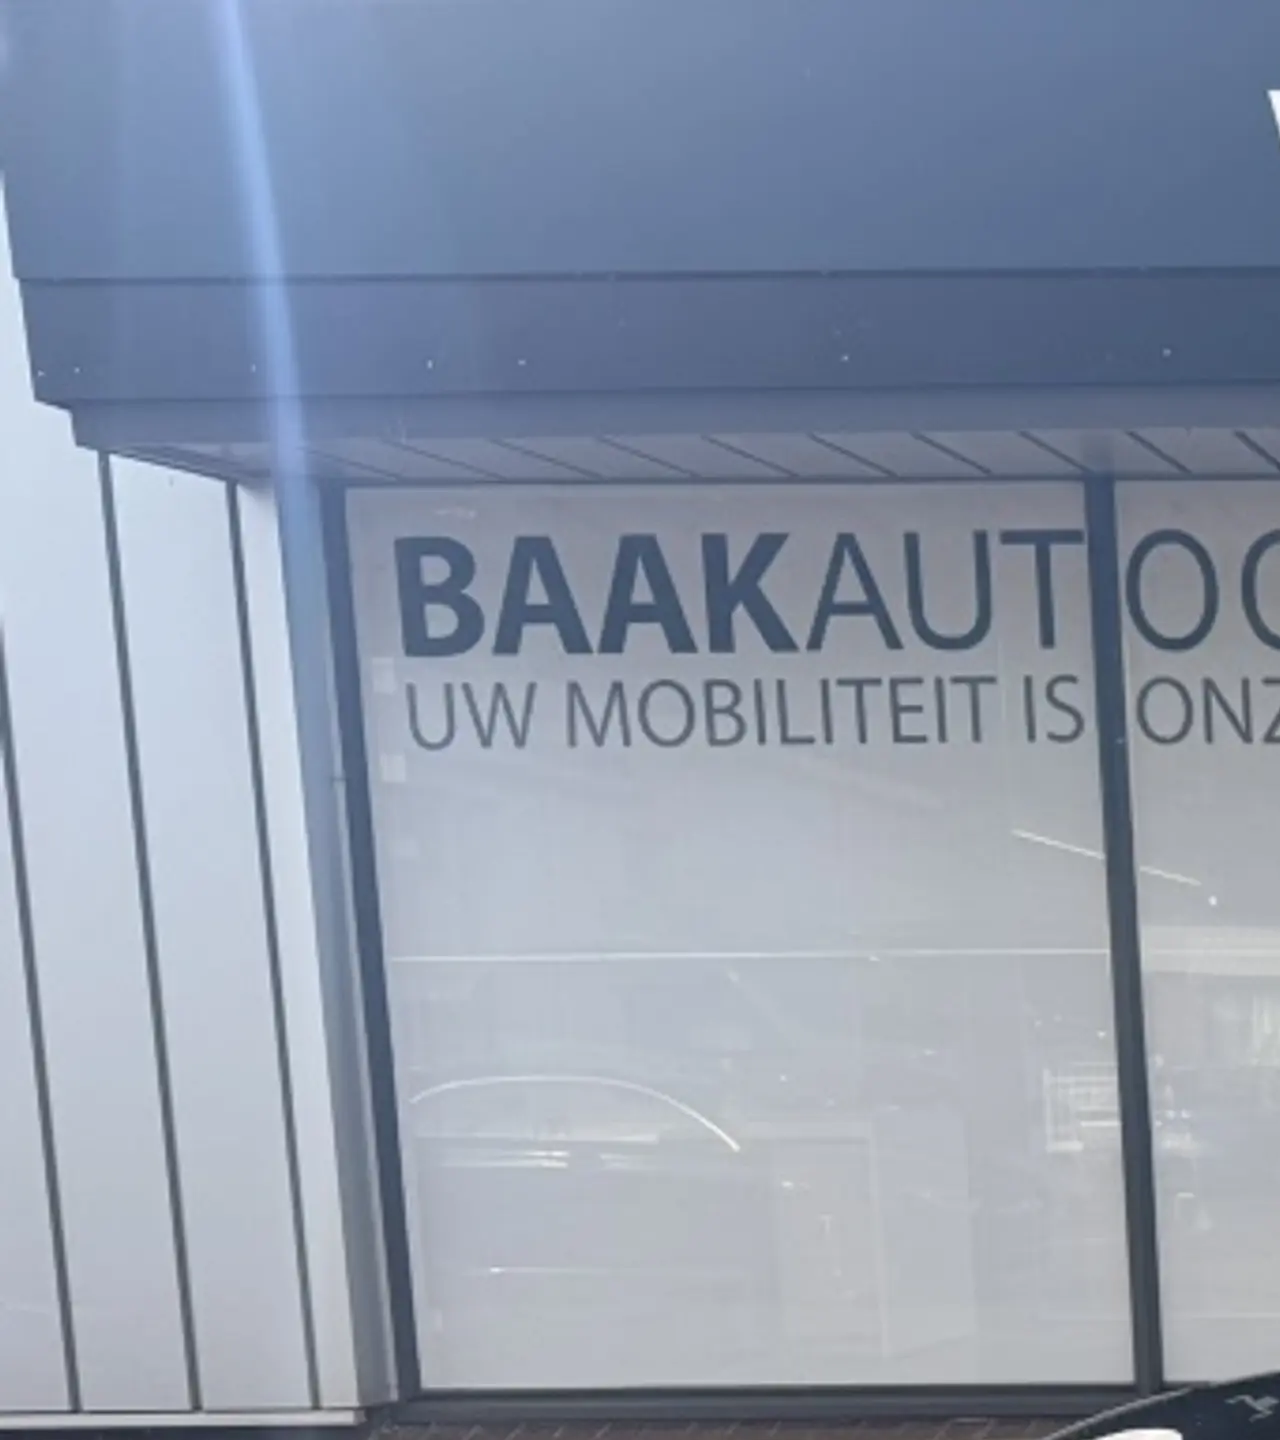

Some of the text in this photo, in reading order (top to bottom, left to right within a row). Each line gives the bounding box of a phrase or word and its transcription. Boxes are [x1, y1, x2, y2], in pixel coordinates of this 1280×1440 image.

[404, 680, 539, 751] UW
[565, 674, 998, 748] MOBILITEIT
[1021, 672, 1086, 745] IS
